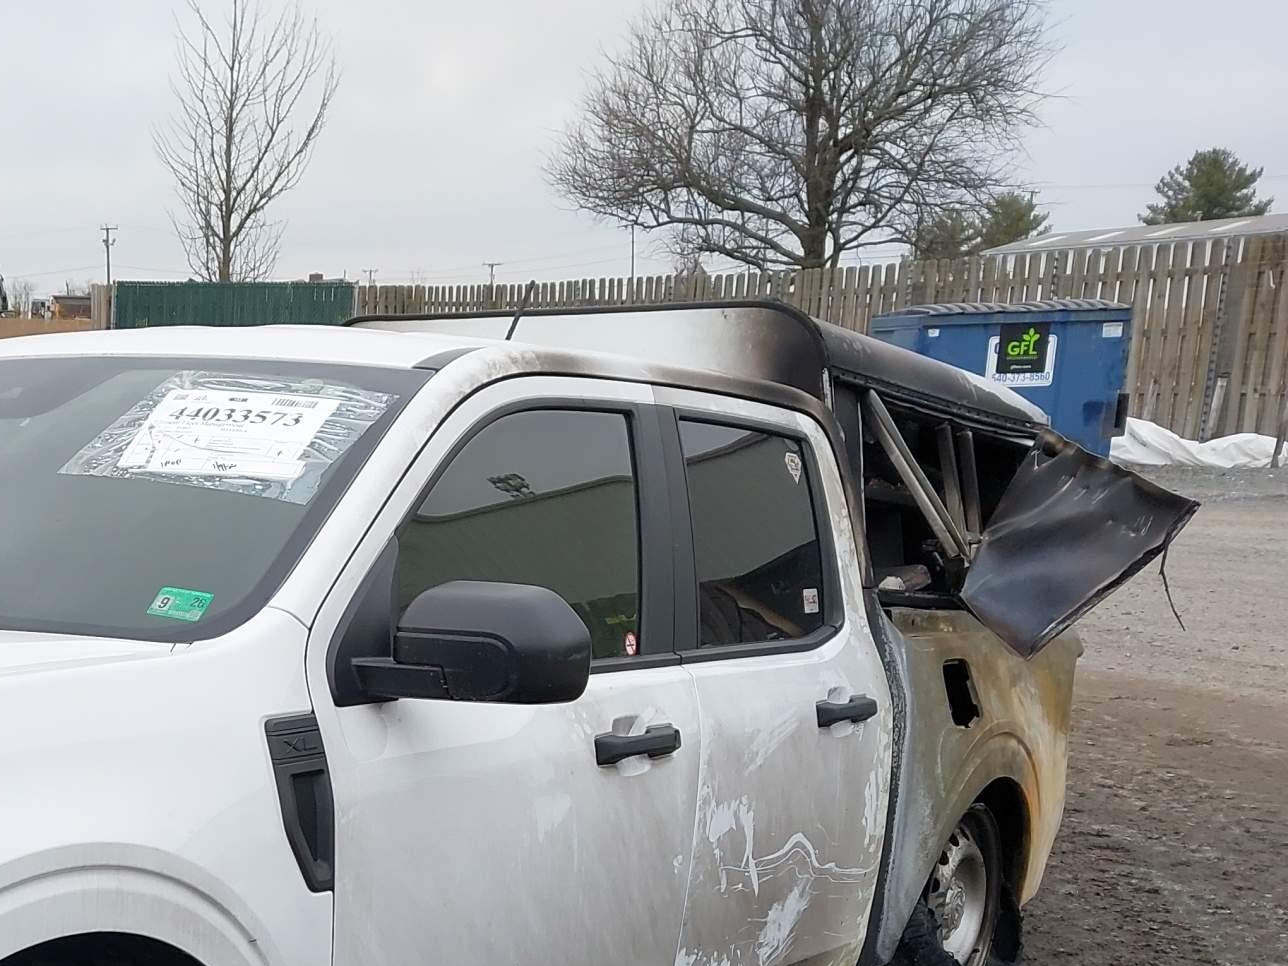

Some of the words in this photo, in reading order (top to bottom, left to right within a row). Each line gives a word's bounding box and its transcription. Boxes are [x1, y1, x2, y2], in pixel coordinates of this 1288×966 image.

[1007, 337, 1038, 356] GFL
[169, 406, 304, 428] 44033573
[158, 596, 171, 609] 9
[190, 597, 207, 609] 26
[283, 736, 318, 754] XL
